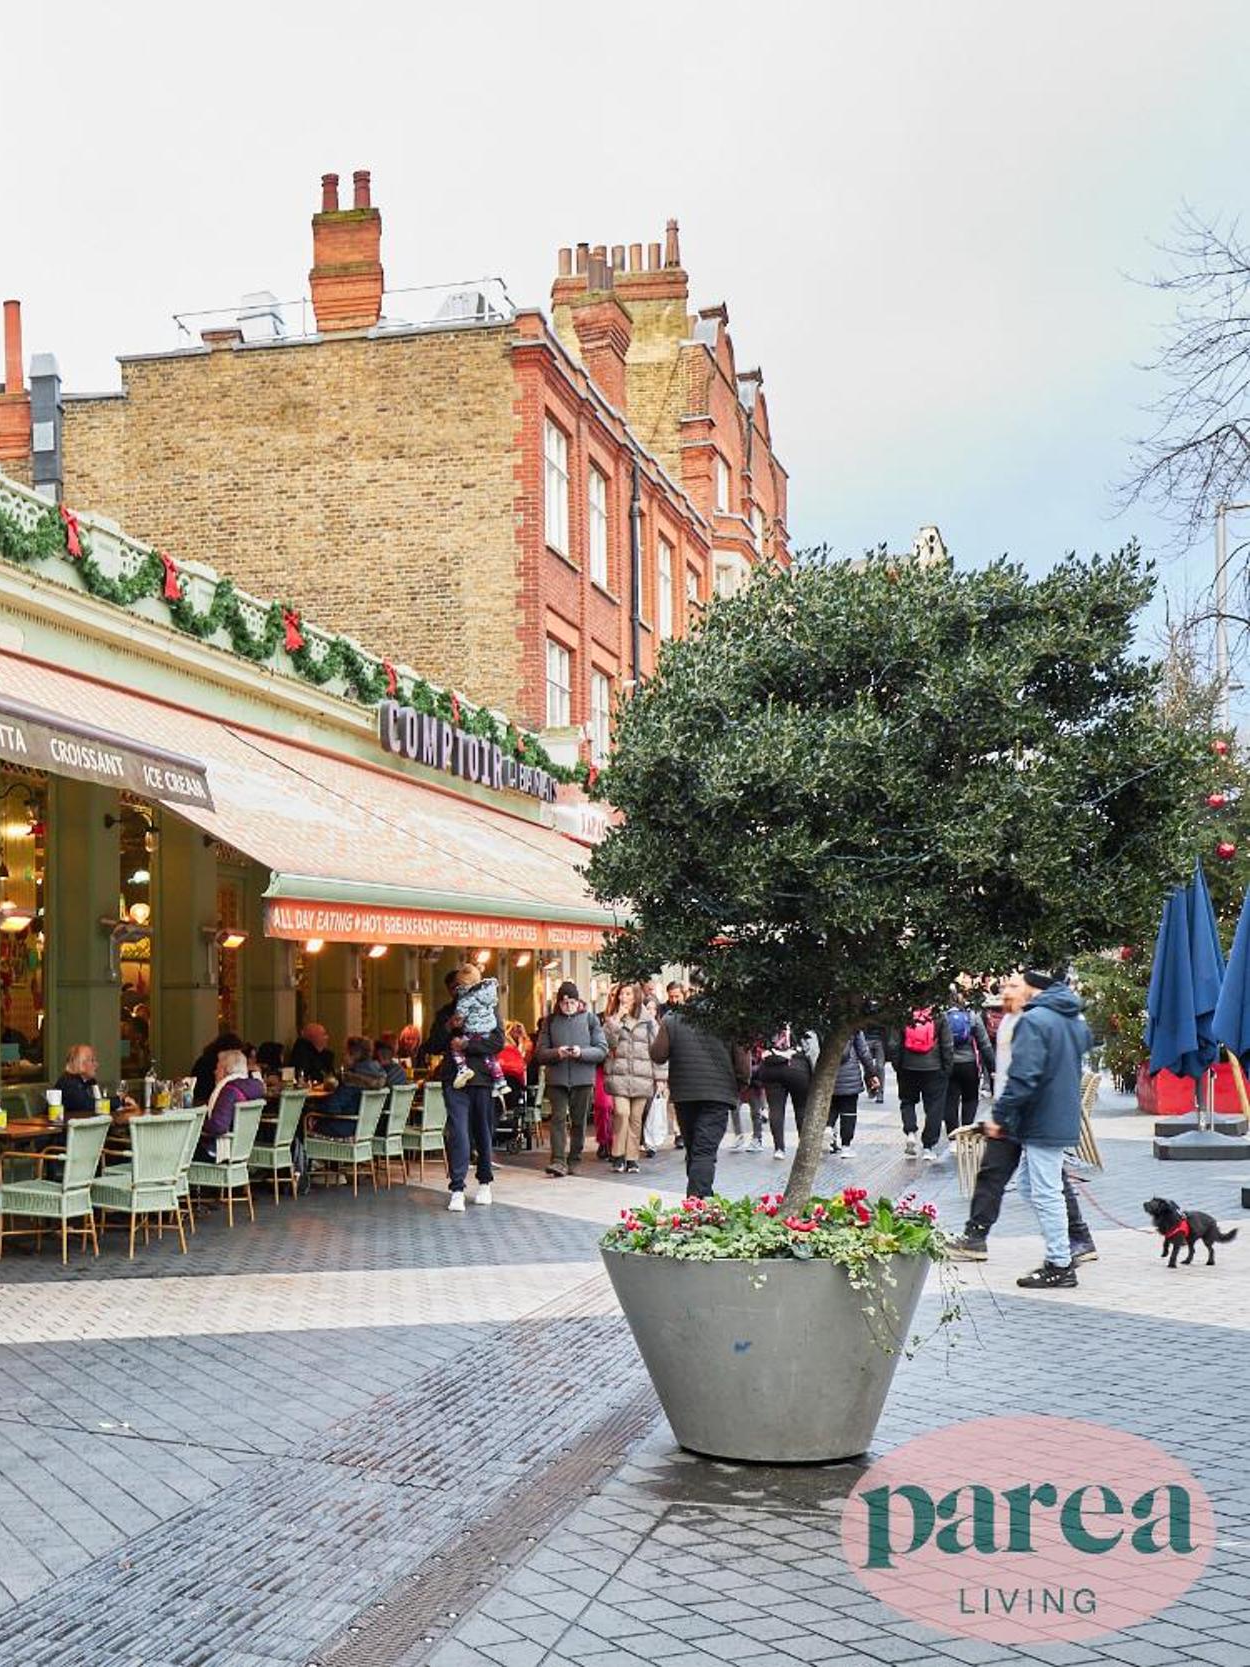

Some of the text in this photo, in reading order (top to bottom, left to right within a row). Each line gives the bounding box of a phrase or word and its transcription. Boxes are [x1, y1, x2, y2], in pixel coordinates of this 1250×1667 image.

[50, 738, 125, 777] CROISSANT
[143, 765, 164, 789] ICE
[164, 771, 208, 799] CREAM
[379, 699, 504, 790] COMPTOIR
[273, 906, 294, 930] ALL
[296, 909, 315, 930] DAY
[317, 910, 354, 932] EATING
[362, 912, 384, 933] HOT
